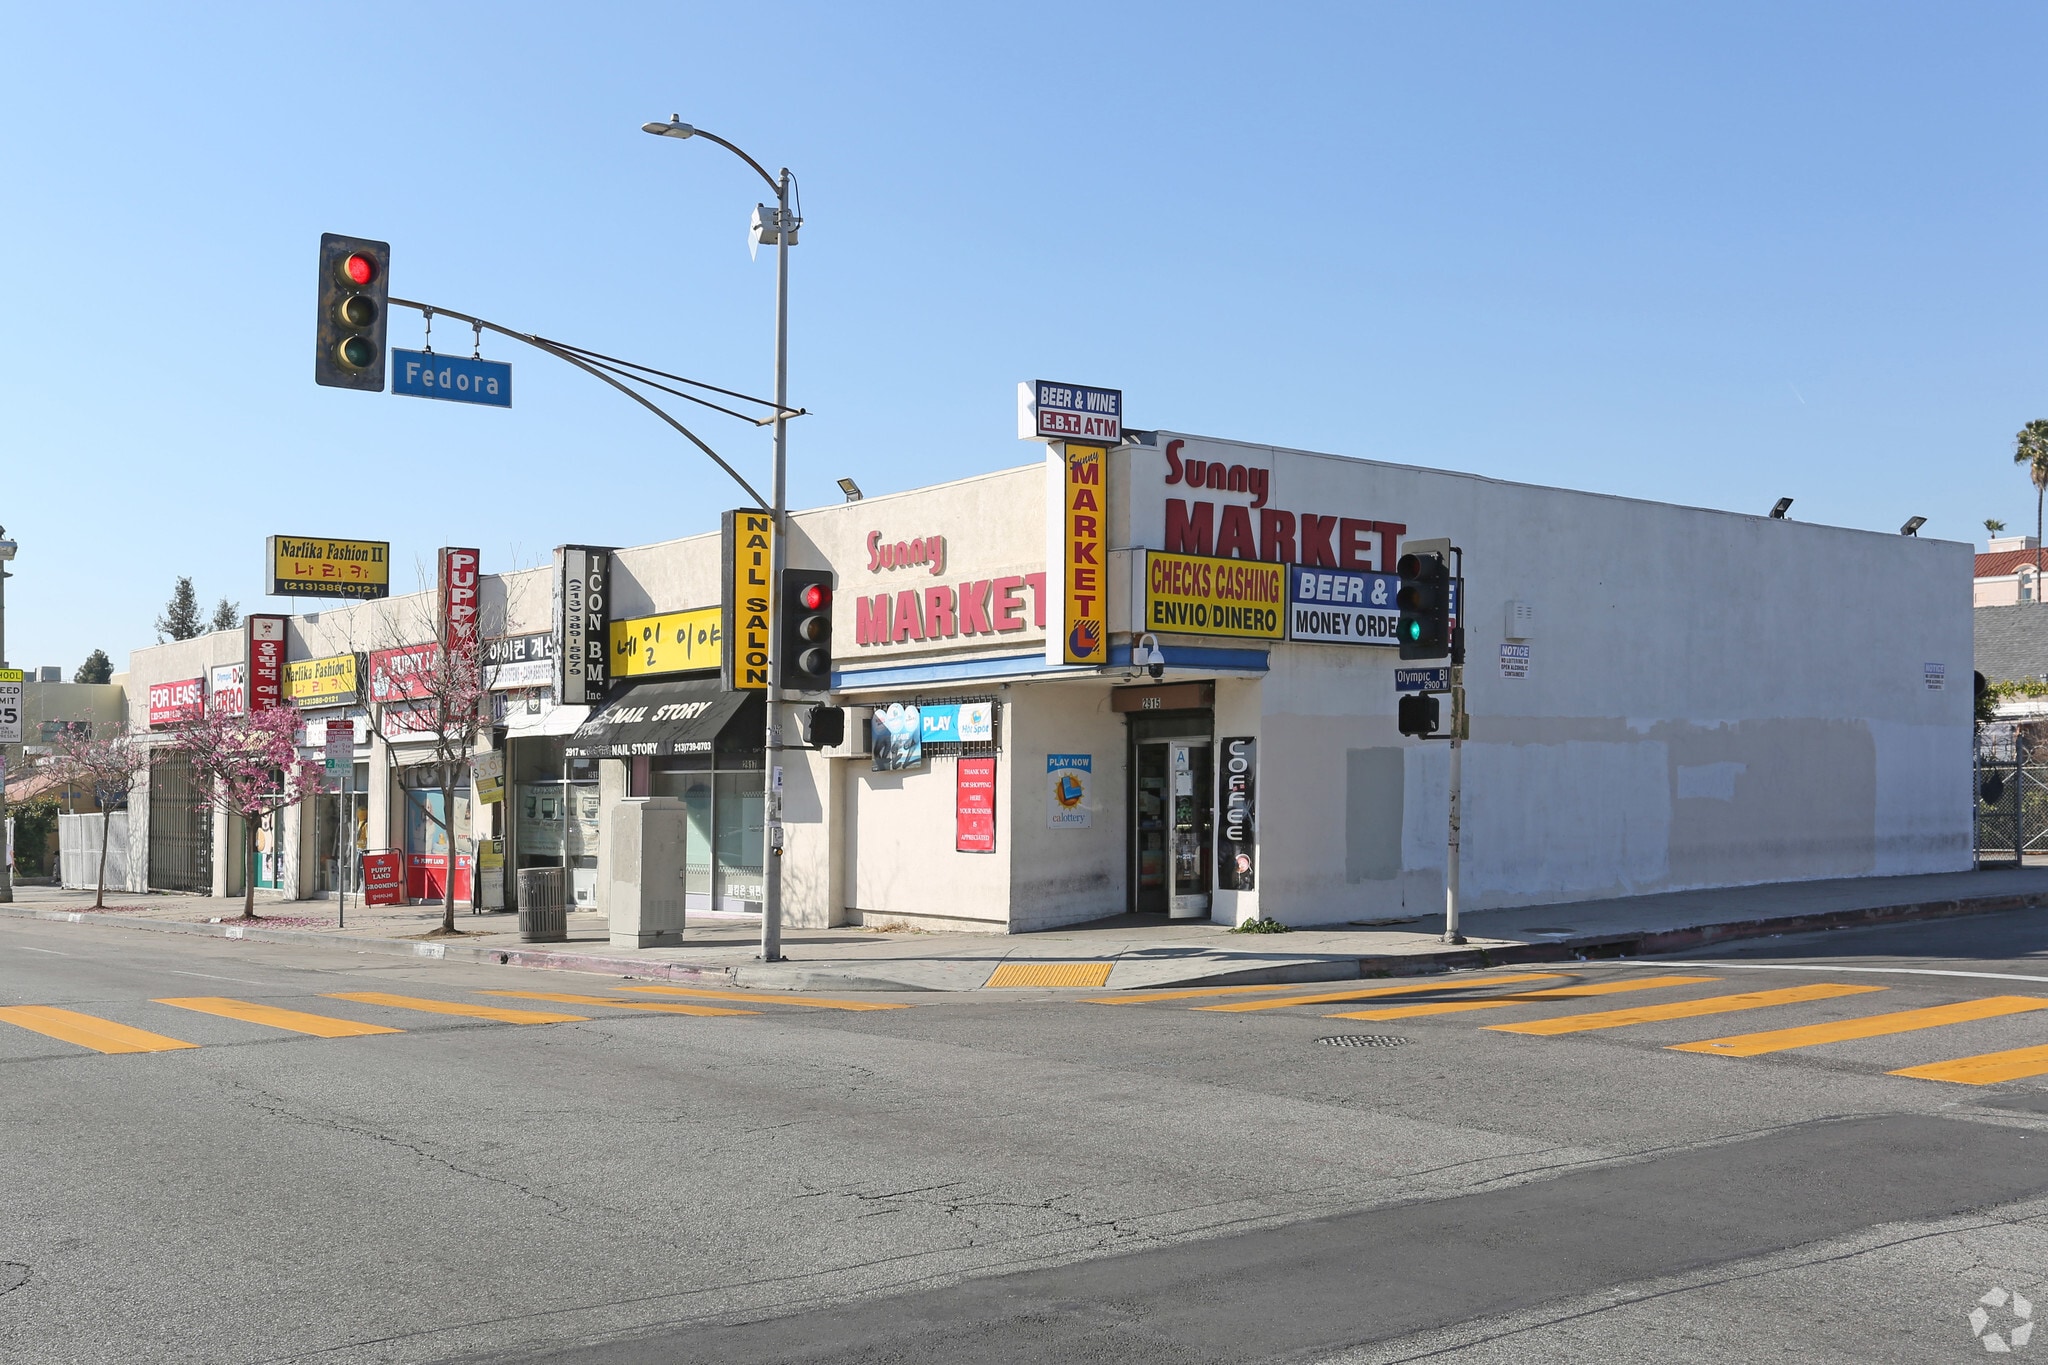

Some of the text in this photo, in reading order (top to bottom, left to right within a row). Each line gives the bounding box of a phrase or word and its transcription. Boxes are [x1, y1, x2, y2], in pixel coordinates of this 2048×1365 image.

[406, 362, 499, 395] Fedora
[1040, 386, 1117, 413] BEER & WINE
[1043, 413, 1117, 438] E.B.T. ATM
[1069, 451, 1099, 471] Sunny
[1165, 439, 1269, 508] Sunny
[1072, 462, 1099, 618] MARKET
[1164, 498, 1407, 573] MARKET
[280, 540, 383, 562] Narlika Fashion II
[746, 517, 768, 586] NAIL
[867, 530, 946, 575] Sunny
[284, 582, 378, 593] (213)388-0121
[1151, 558, 1279, 604] CHECKS CASHING
[1299, 572, 1388, 606] BEER &
[452, 554, 474, 638] PUPPY
[588, 556, 603, 631] ICON
[856, 572, 1046, 645] MARKET
[1153, 600, 1277, 633] ENVIO/DINERO
[569, 578, 582, 675] (213)389-5679
[1296, 610, 1401, 638] MONEY ORDE
[746, 598, 768, 684] SALON
[1501, 645, 1528, 657] NOTICE
[285, 662, 312, 683] Narlika
[315, 661, 345, 678] Fashion
[1397, 669, 1448, 685] Olympic Bl
[150, 683, 201, 709] FOR LEASE
[586, 690, 604, 700] Inc.
[1424, 681, 1440, 689] 2900
[0, 708, 17, 723] 5
[609, 701, 713, 725] NAIL STORY
[1142, 698, 1161, 709] 2915
[923, 716, 951, 732] PLAY
[962, 724, 989, 734] Hot Spot
[611, 744, 630, 756] NAIL
[631, 742, 658, 755] STORY
[1176, 751, 1186, 763] A
[327, 760, 333, 768] 2
[1049, 758, 1089, 767] PLAY NOW
[1227, 740, 1248, 841] COFFEE
[1052, 812, 1086, 823] calottery
[370, 866, 392, 874] PUPPY
